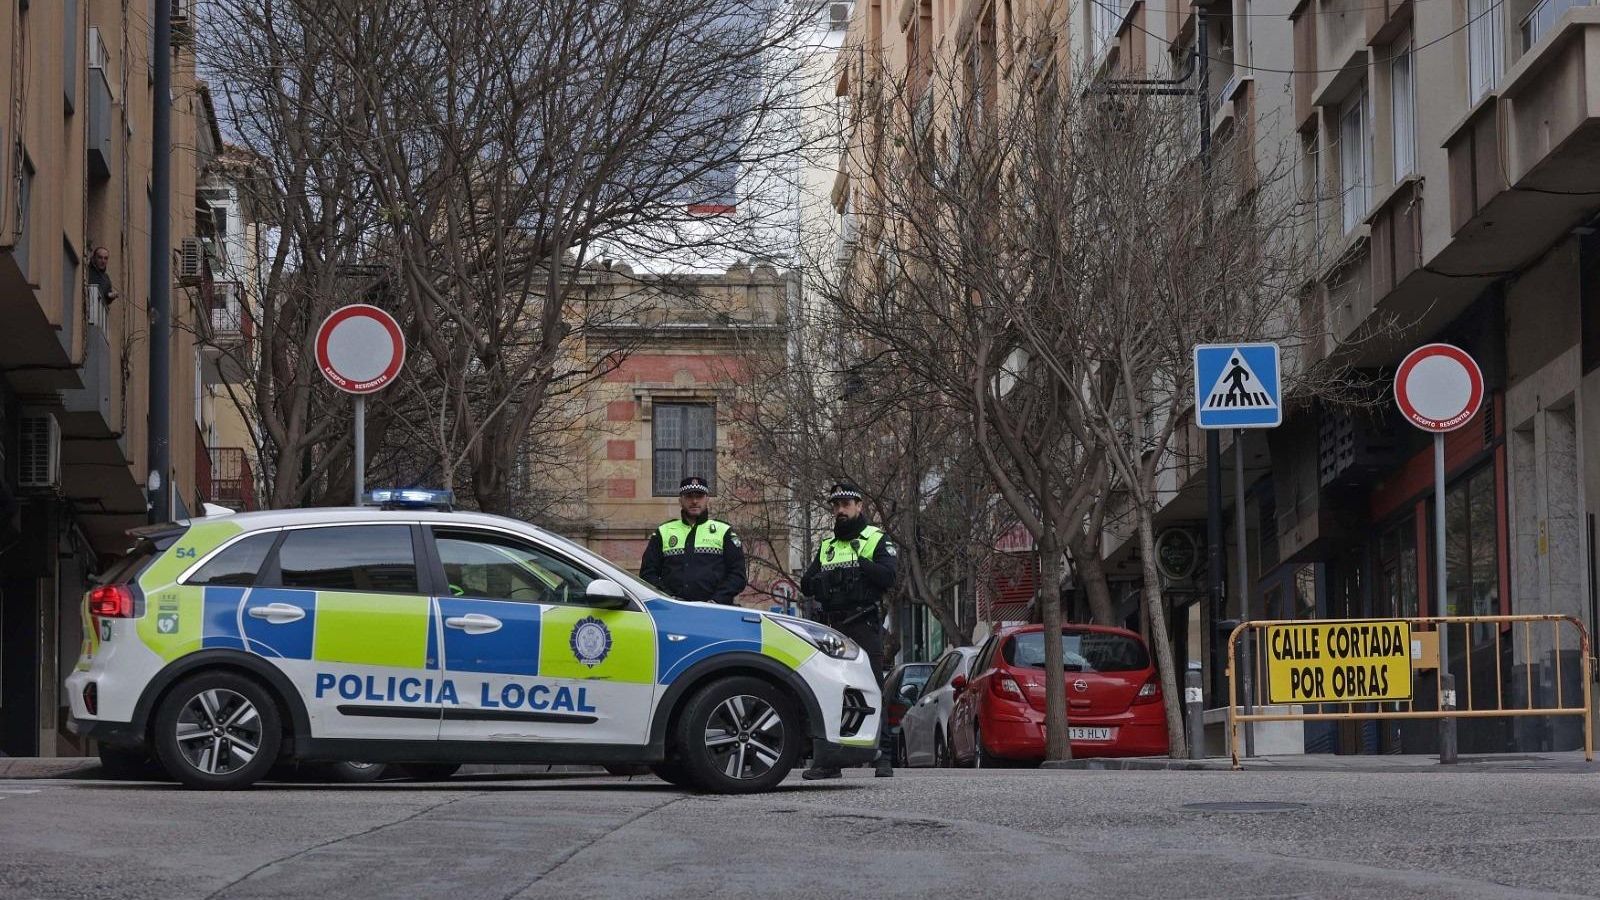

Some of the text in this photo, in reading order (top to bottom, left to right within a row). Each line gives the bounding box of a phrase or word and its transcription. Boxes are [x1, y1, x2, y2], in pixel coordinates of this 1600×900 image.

[325, 367, 388, 389] EXCEPTO RESIDENTES
[1412, 410, 1471, 428] EXCEPTO RESIDENTES
[176, 547, 196, 559] 54
[1272, 625, 1405, 660] CALLE CORTADA
[1290, 664, 1389, 699] POR OBRAS
[315, 673, 596, 713] POLICIA LOCAL
[1067, 728, 1108, 739] 13 HLV
